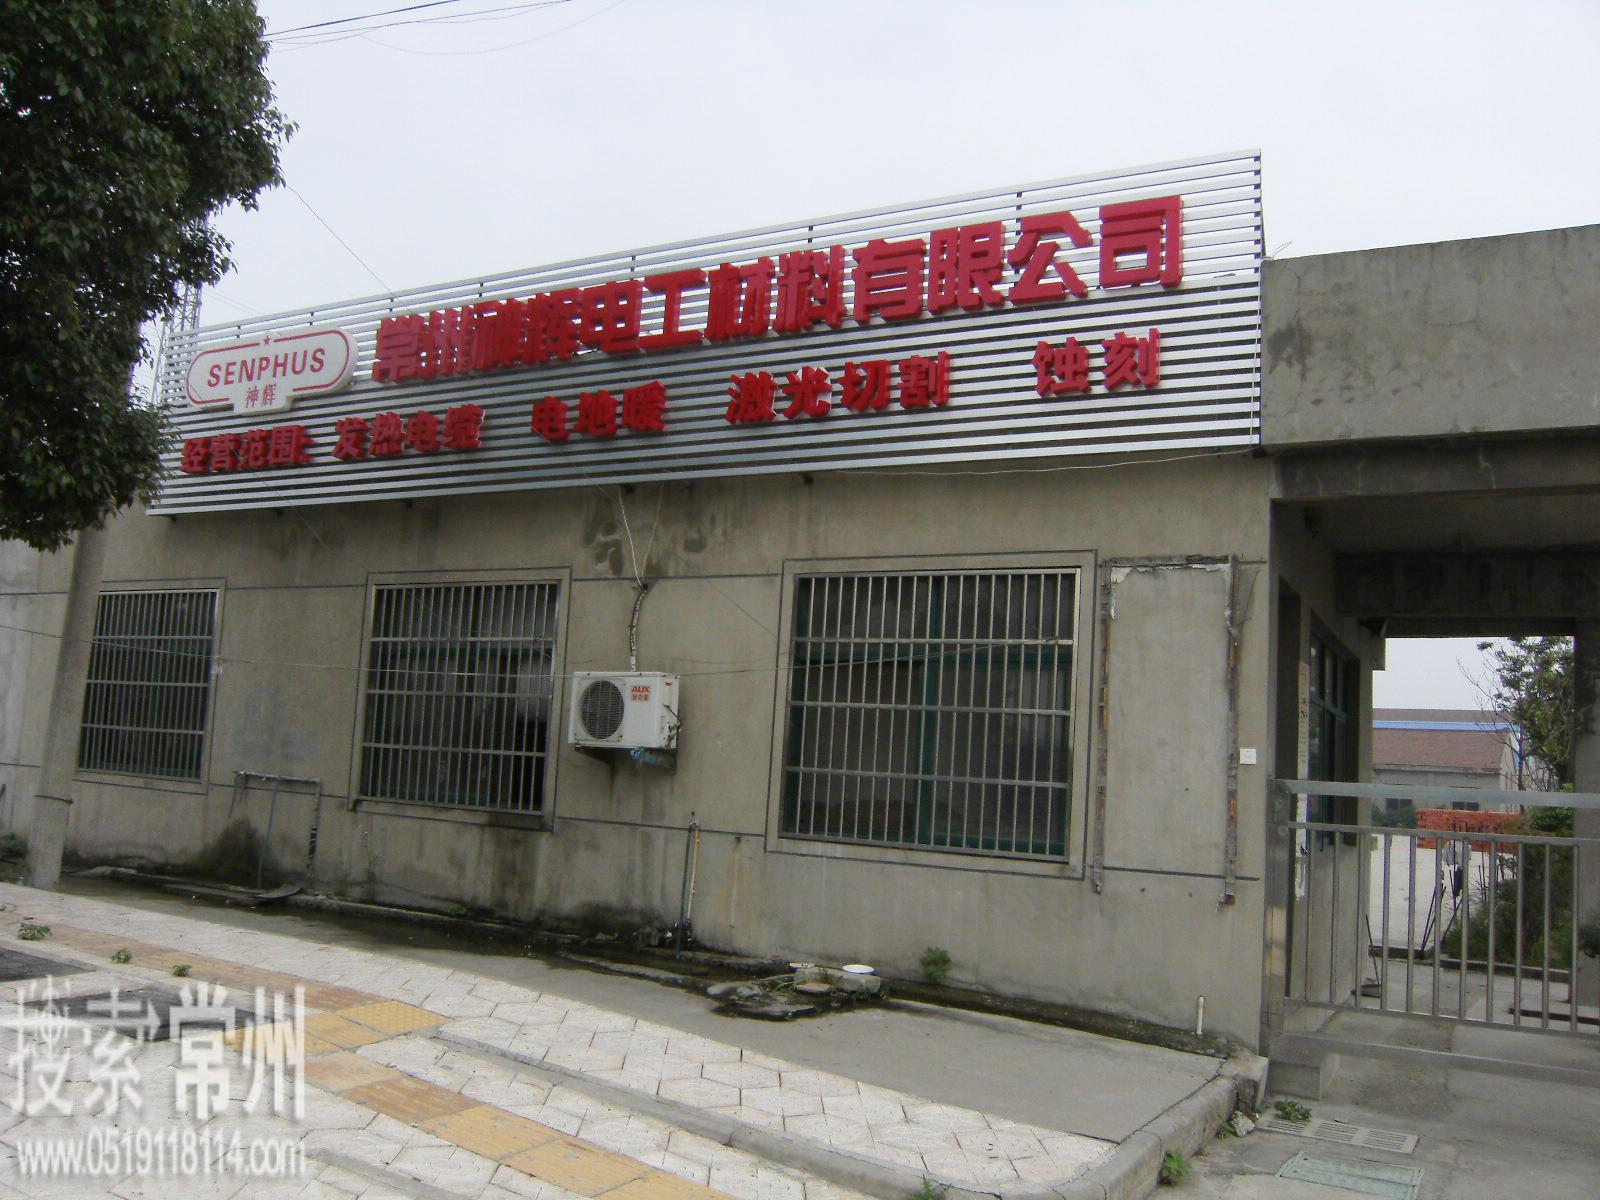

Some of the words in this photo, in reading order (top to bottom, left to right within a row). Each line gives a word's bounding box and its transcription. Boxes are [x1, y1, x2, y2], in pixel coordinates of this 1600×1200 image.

[207, 347, 326, 388] SENPHUS
[245, 383, 277, 408] 神辉
[331, 403, 484, 461] 发热电缆
[531, 380, 670, 441] 电地暖
[725, 350, 951, 424] 激光切割
[1032, 327, 1162, 398] 蚀刻
